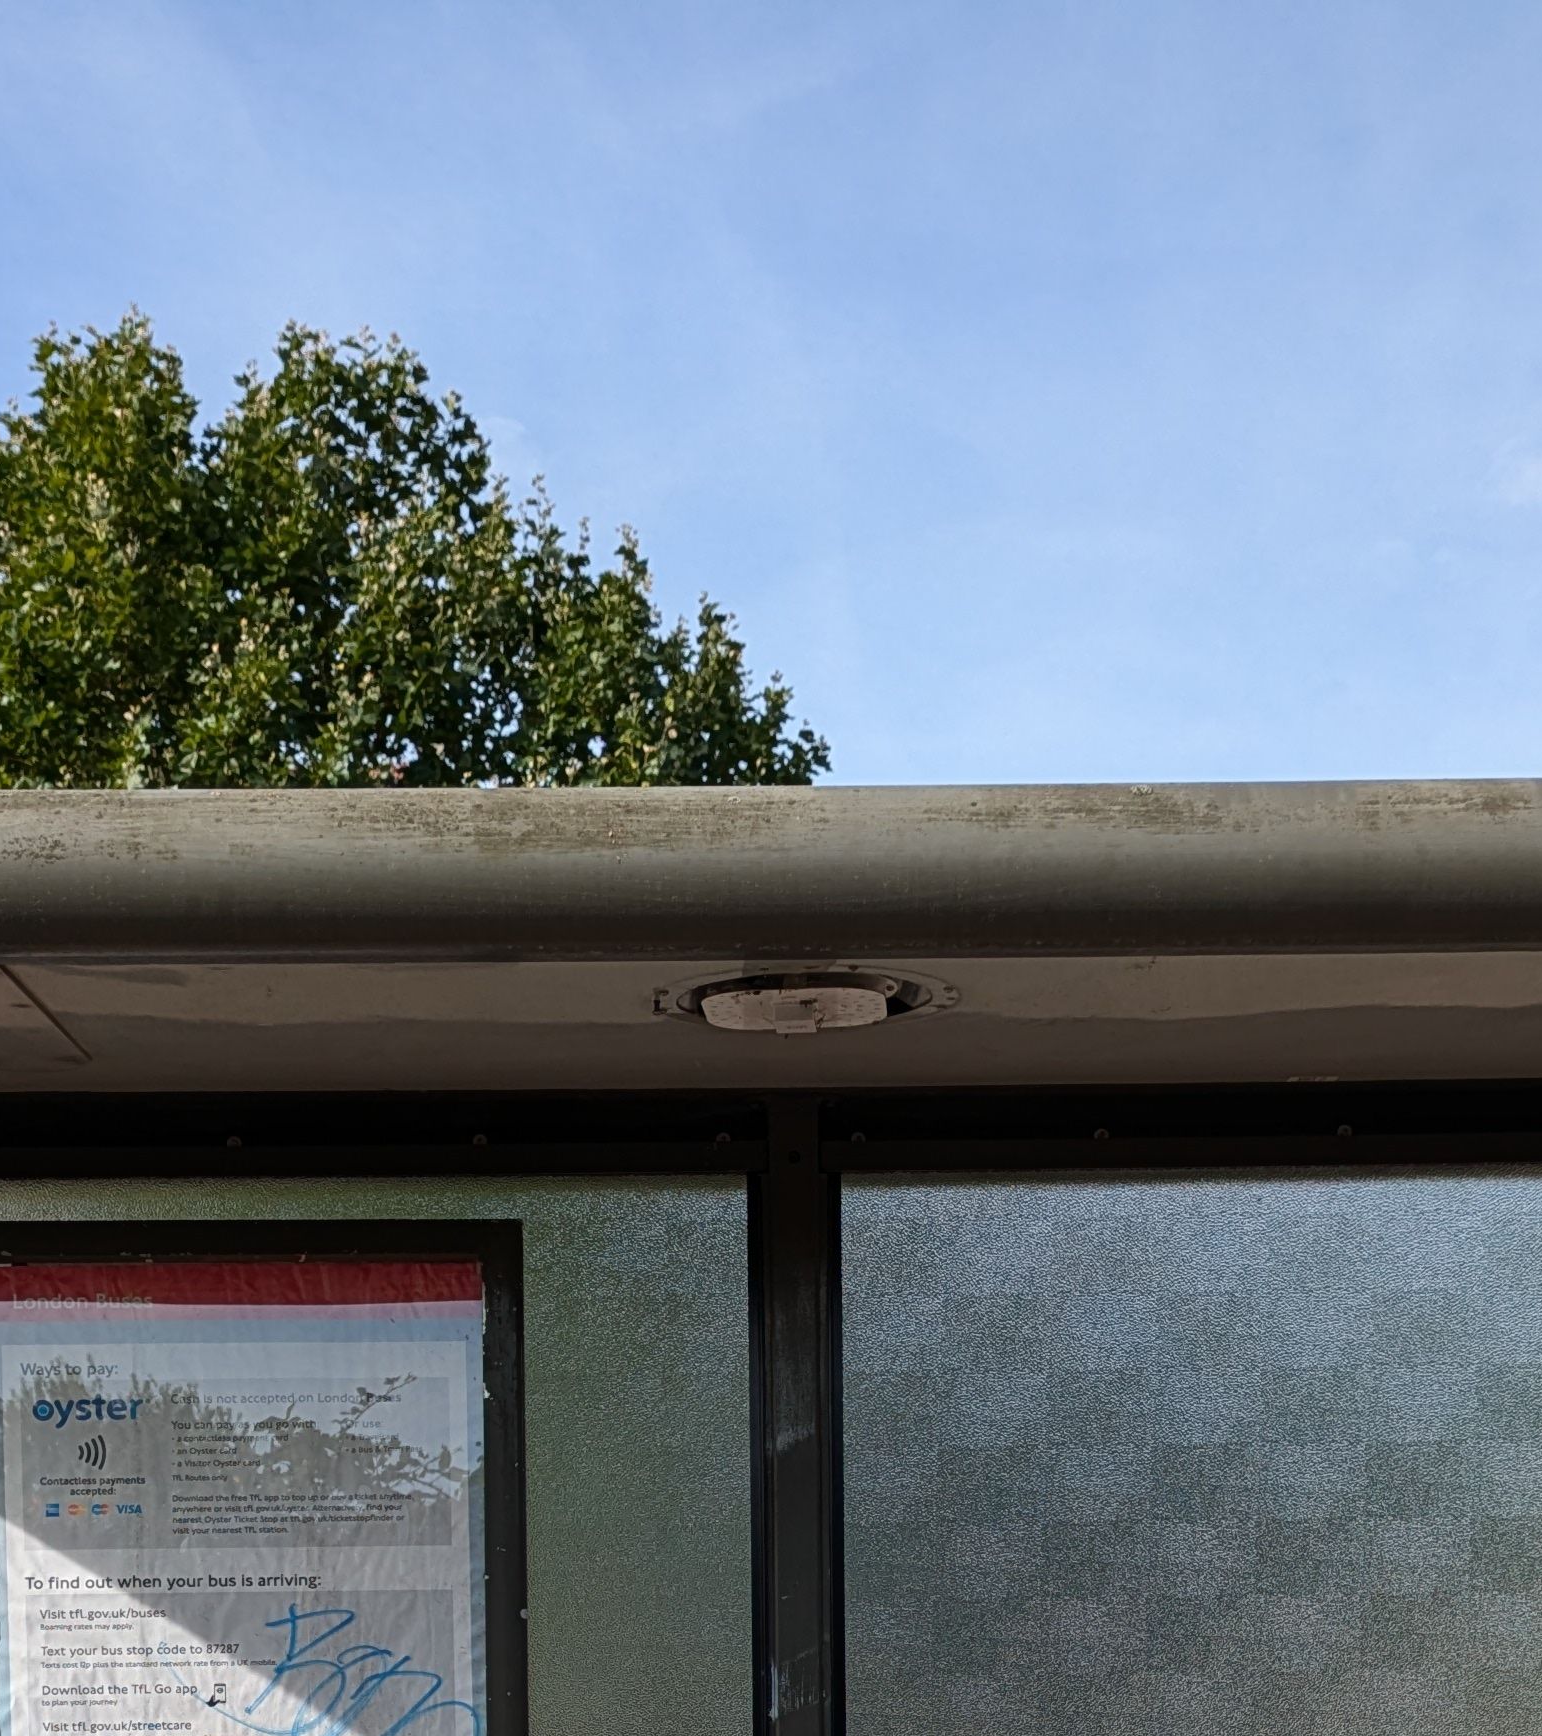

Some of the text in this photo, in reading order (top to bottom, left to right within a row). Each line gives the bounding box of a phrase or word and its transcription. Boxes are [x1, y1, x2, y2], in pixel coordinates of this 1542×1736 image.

[12, 1292, 154, 1310] London Buses
[20, 1362, 118, 1380] Ways to pay:
[171, 1393, 200, 1405] Cash
[204, 1393, 213, 1404] is
[217, 1393, 236, 1404] not
[241, 1392, 295, 1406] accepted
[298, 1393, 314, 1403] on
[317, 1392, 362, 1403] London
[32, 1393, 144, 1429] oyster
[171, 1420, 289, 1433] You can pay you go
[176, 1446, 237, 1456] an Oyster card
[184, 1459, 211, 1468] Visitor
[213, 1459, 240, 1469] Oyster
[243, 1459, 261, 1467] card
[39, 1476, 146, 1487] Contactless payments
[70, 1487, 117, 1497] accepted:
[172, 1494, 214, 1502] Download
[215, 1494, 230, 1502] the
[231, 1494, 248, 1502] free
[264, 1495, 279, 1504] app
[281, 1494, 290, 1502] to
[292, 1494, 306, 1503] top
[308, 1495, 318, 1503] up
[354, 1493, 377, 1501] ticket
[115, 1504, 143, 1515] VISA
[172, 1506, 212, 1515] anywhere
[225, 1505, 241, 1513] visit
[367, 1503, 382, 1512] find
[384, 1504, 403, 1513] your
[172, 1515, 202, 1524] nearest
[204, 1515, 232, 1525] Oyster
[234, 1515, 258, 1523] Ticket
[260, 1515, 279, 1524] Stop
[172, 1526, 190, 1535] visit
[191, 1527, 210, 1536] your
[212, 1526, 243, 1535] nearest
[259, 1526, 289, 1534] station.
[25, 1573, 322, 1592] To find out when your bus is arriving:
[40, 1608, 67, 1620] Visit
[40, 1623, 135, 1632] Roaming rates may apply.
[41, 1643, 240, 1658] Text your bus stop code to 87287
[41, 1661, 60, 1669] Texts
[62, 1661, 79, 1669] cost
[93, 1661, 109, 1669] plus
[125, 1660, 158, 1668] standard
[159, 1660, 192, 1668] network
[237, 1659, 249, 1667] UK
[42, 1685, 105, 1696] Download
[107, 1684, 129, 1695] the
[155, 1684, 172, 1695] Go
[175, 1685, 198, 1697] app
[42, 1698, 119, 1708] to plan your journey
[42, 1721, 69, 1732] Visit
